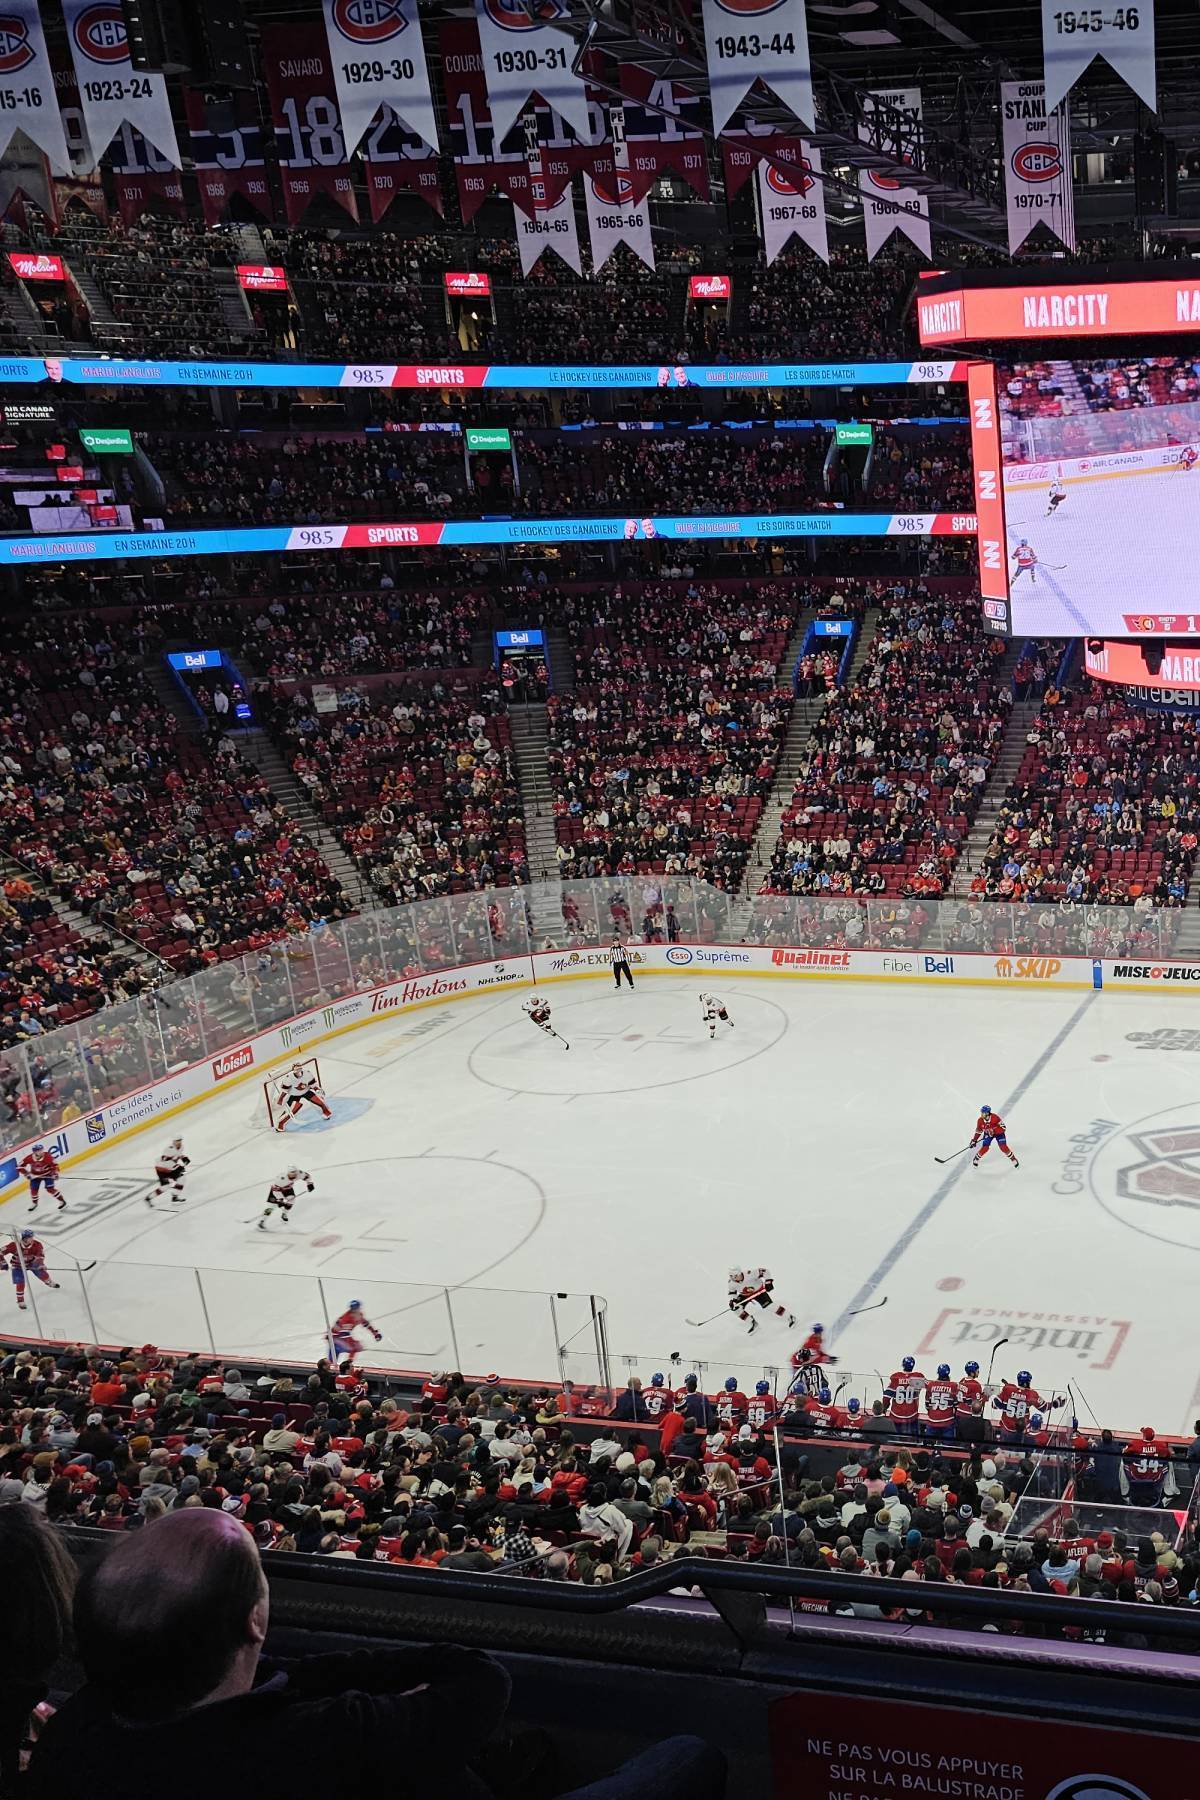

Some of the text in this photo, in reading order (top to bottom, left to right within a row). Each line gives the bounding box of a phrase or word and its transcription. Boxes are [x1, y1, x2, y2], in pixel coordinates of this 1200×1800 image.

[1053, 8, 1139, 34] 1945-46
[715, 33, 796, 59] 1943-44
[279, 58, 324, 78] SAVARD
[493, 47, 568, 73] 1930-31
[341, 59, 415, 84] 1929-30
[83, 78, 153, 102] 1923-24
[282, 96, 346, 168] 18
[1026, 121, 1048, 132] CUP
[593, 159, 613, 173] 1975
[635, 156, 657, 171] 1950
[683, 154, 703, 169] 1971
[730, 152, 751, 166] 1950
[548, 161, 569, 176] 1955
[289, 180, 310, 194] 1966
[373, 175, 393, 189] 1970
[418, 173, 437, 187] 1979
[464, 177, 485, 192] 1963
[508, 175, 527, 189] 1979
[123, 187, 143, 200] 1971
[206, 182, 225, 197] 1968
[1014, 193, 1062, 208] 1970-71
[769, 205, 818, 221] 1967-68
[522, 219, 569, 234] 1964-65
[596, 214, 644, 229] 1965-66
[921, 300, 961, 335] NARCITY
[1024, 293, 1109, 328] NARCITY
[178, 368, 233, 380] EN SEMAINE
[353, 368, 464, 384] 98.5 SPORTS
[560, 371, 652, 383] HOCKEY DES CANADIENS
[784, 369, 856, 380] LES SOIRS MATCH
[519, 523, 618, 537] HOCKEY DES CANADIENS
[757, 519, 832, 532] LES SOIRS MATCH
[897, 516, 925, 532] 98.5
[299, 527, 419, 546] 98.5 SPORTS
[115, 539, 175, 551] EN SEMAINE
[825, 623, 842, 634] Bell
[1187, 616, 1197, 632] 1
[510, 633, 529, 644] Bell
[185, 654, 207, 668] Bell
[670, 950, 749, 964] Esso Suprême
[771, 948, 851, 966] Qualinet
[883, 956, 954, 973] Fibe Bell
[1014, 958, 1061, 979] SKIP
[369, 989, 400, 1013] Tim
[401, 978, 468, 1006] Hortons
[215, 1051, 252, 1077] Voisin
[108, 1103, 127, 1119] Les
[111, 1091, 183, 1133] prennent vie ici
[90, 1130, 105, 1144] RBC
[1051, 1118, 1121, 1196] CentreBell
[969, 1307, 1108, 1326] ASSURANCE
[950, 1320, 1105, 1359] intact
[896, 1386, 915, 1405] 60
[931, 1392, 950, 1411] 55
[1006, 1400, 1027, 1419] 58
[807, 1738, 1024, 1781] NE PAS VOUS APPUYER
[829, 1764, 1025, 1800] SUR LA BALUSTRADE
